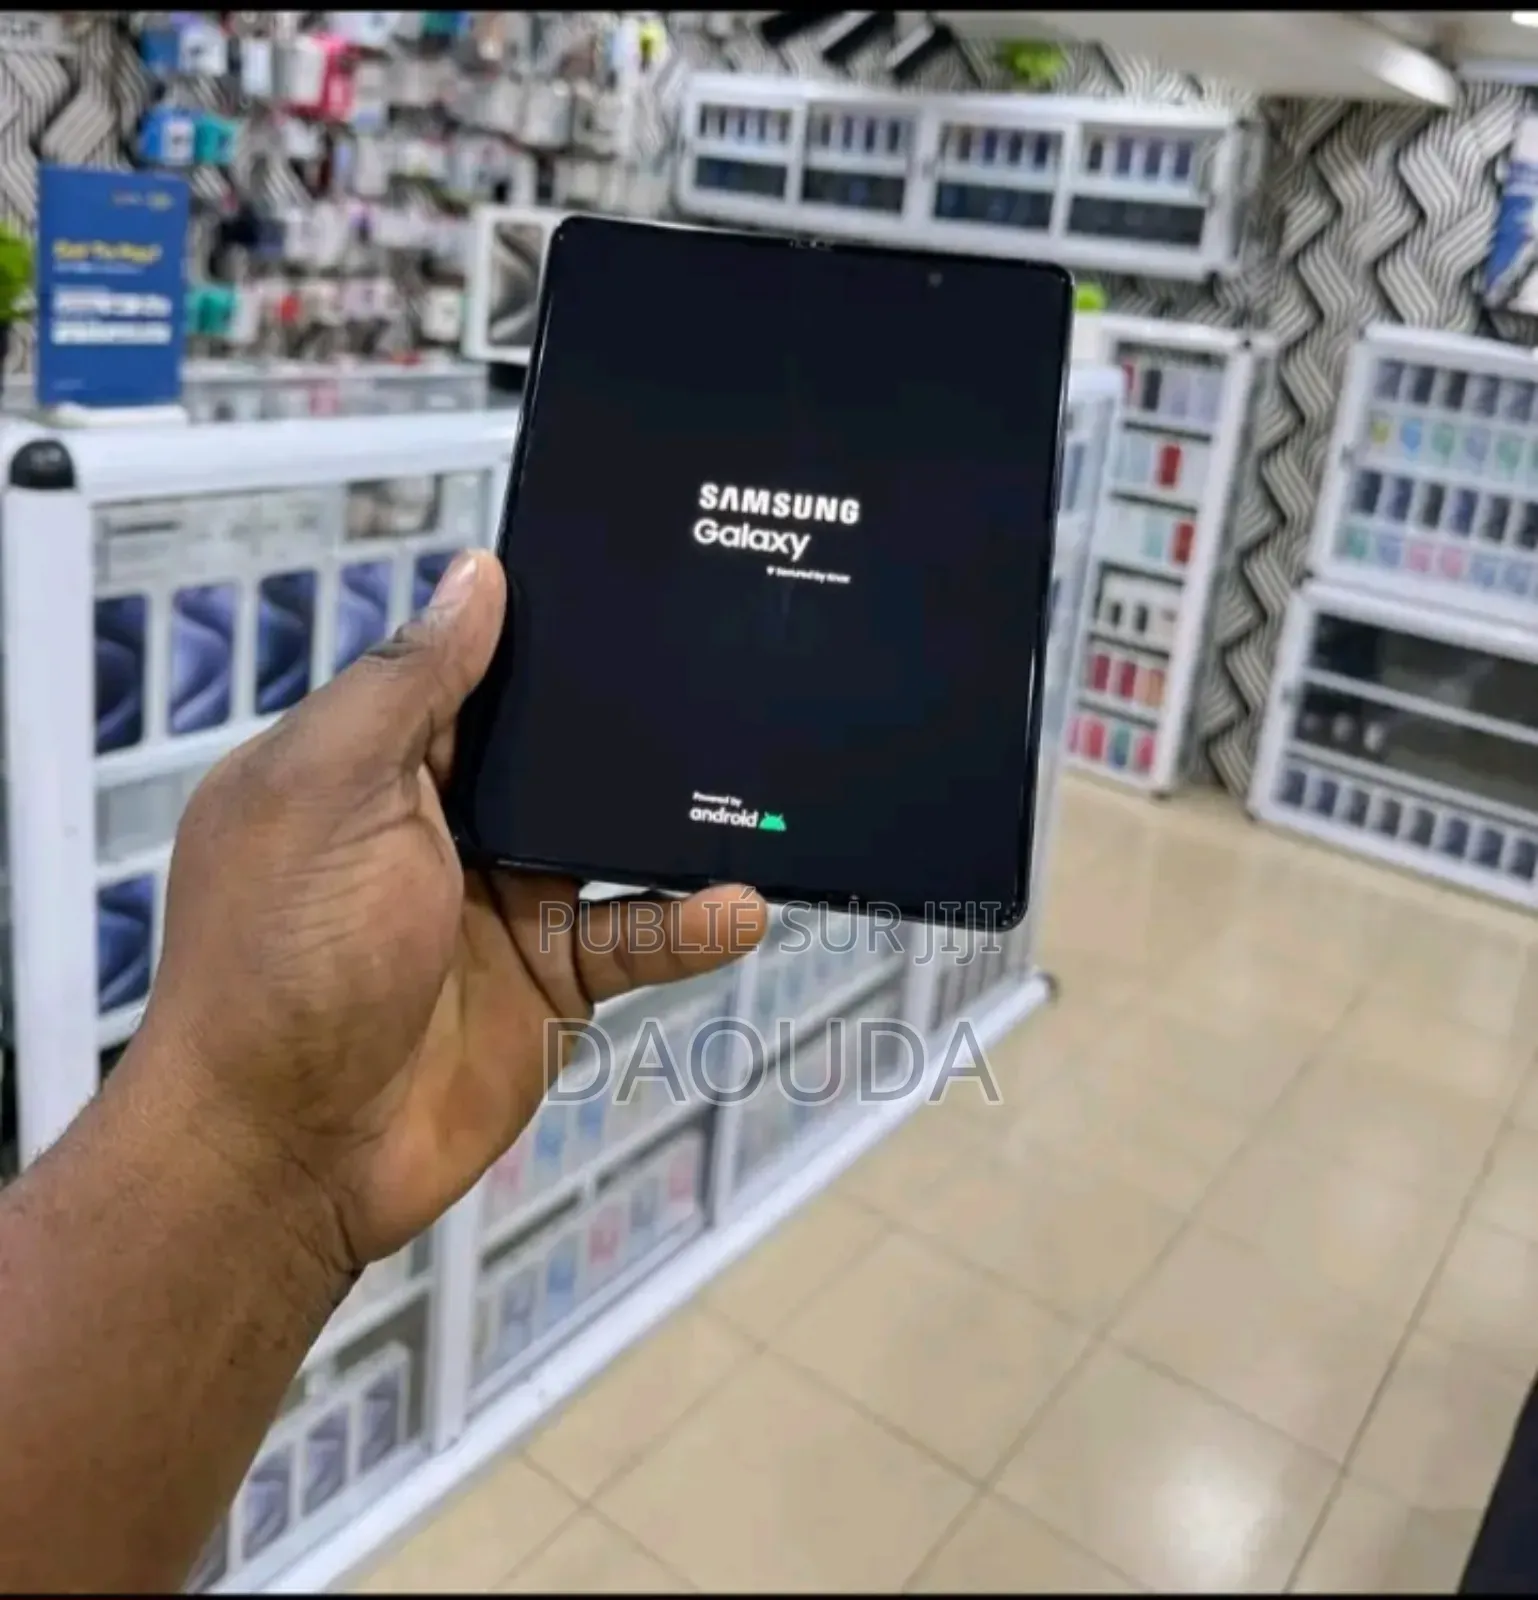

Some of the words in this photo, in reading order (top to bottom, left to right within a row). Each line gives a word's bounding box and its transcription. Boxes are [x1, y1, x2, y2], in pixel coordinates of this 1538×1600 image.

[698, 482, 861, 525] SAMSUNG
[692, 517, 812, 562] Galaxy
[689, 806, 759, 828] android
